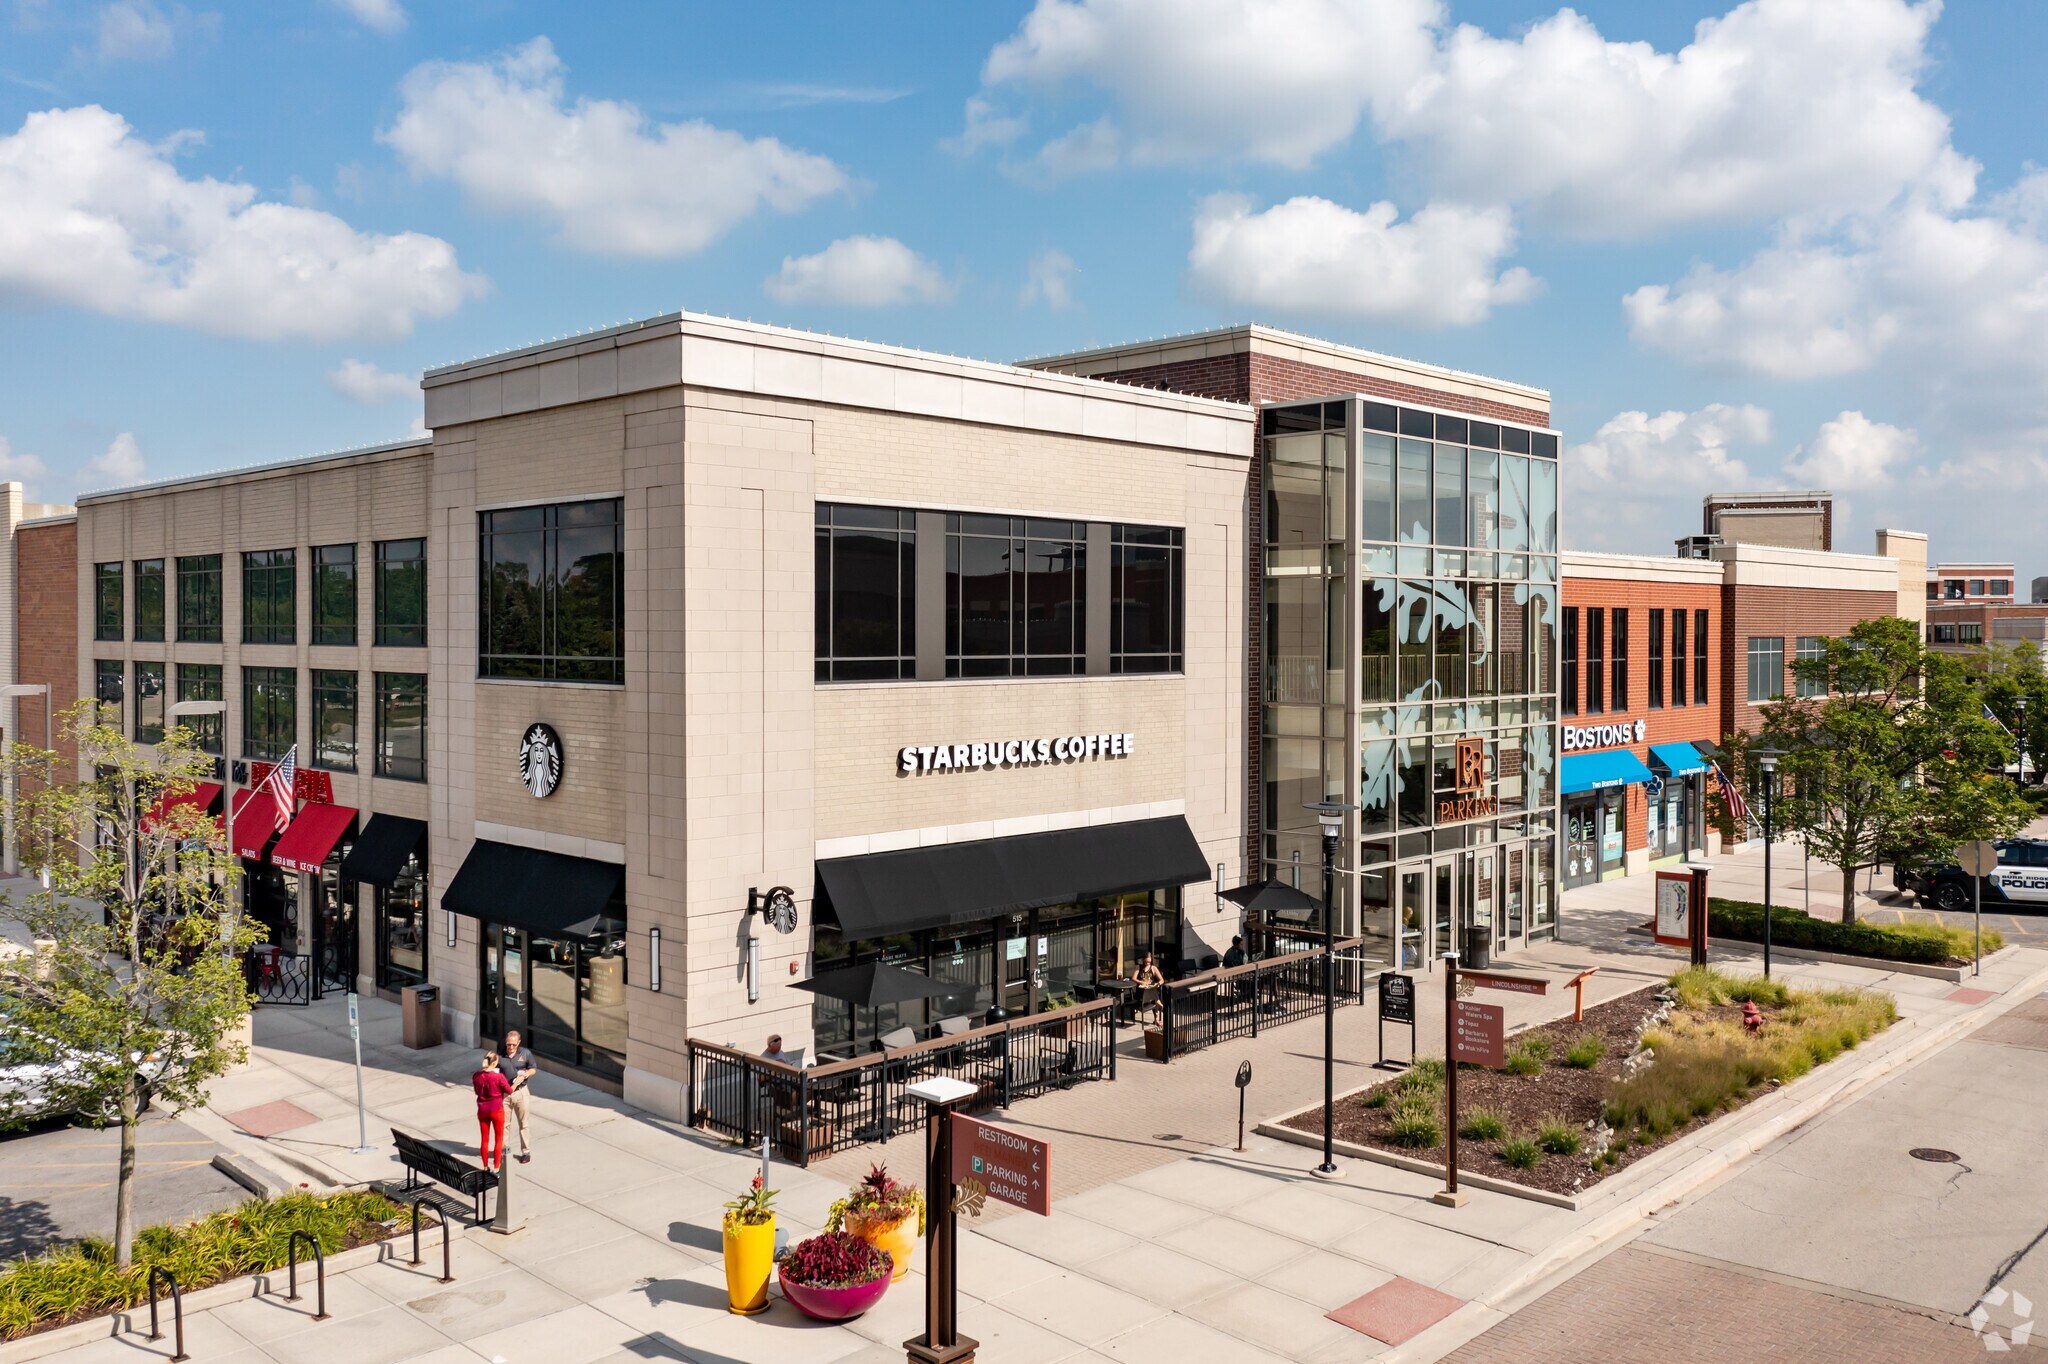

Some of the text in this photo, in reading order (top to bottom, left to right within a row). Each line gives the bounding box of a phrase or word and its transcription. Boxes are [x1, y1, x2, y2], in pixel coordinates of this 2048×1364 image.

[1564, 724, 1632, 750] BOSTONS
[902, 733, 1135, 771] STARBUCKS COFFEE
[1440, 794, 1497, 822] PARKING
[2002, 879, 2048, 890] POLIC
[1012, 914, 1023, 923] 515
[1491, 980, 1532, 991] LINCOLNSHIRE
[978, 1126, 1028, 1153] RESTROOM
[974, 1158, 1028, 1187] P PARKING
[989, 1181, 1028, 1205] GARAGE
